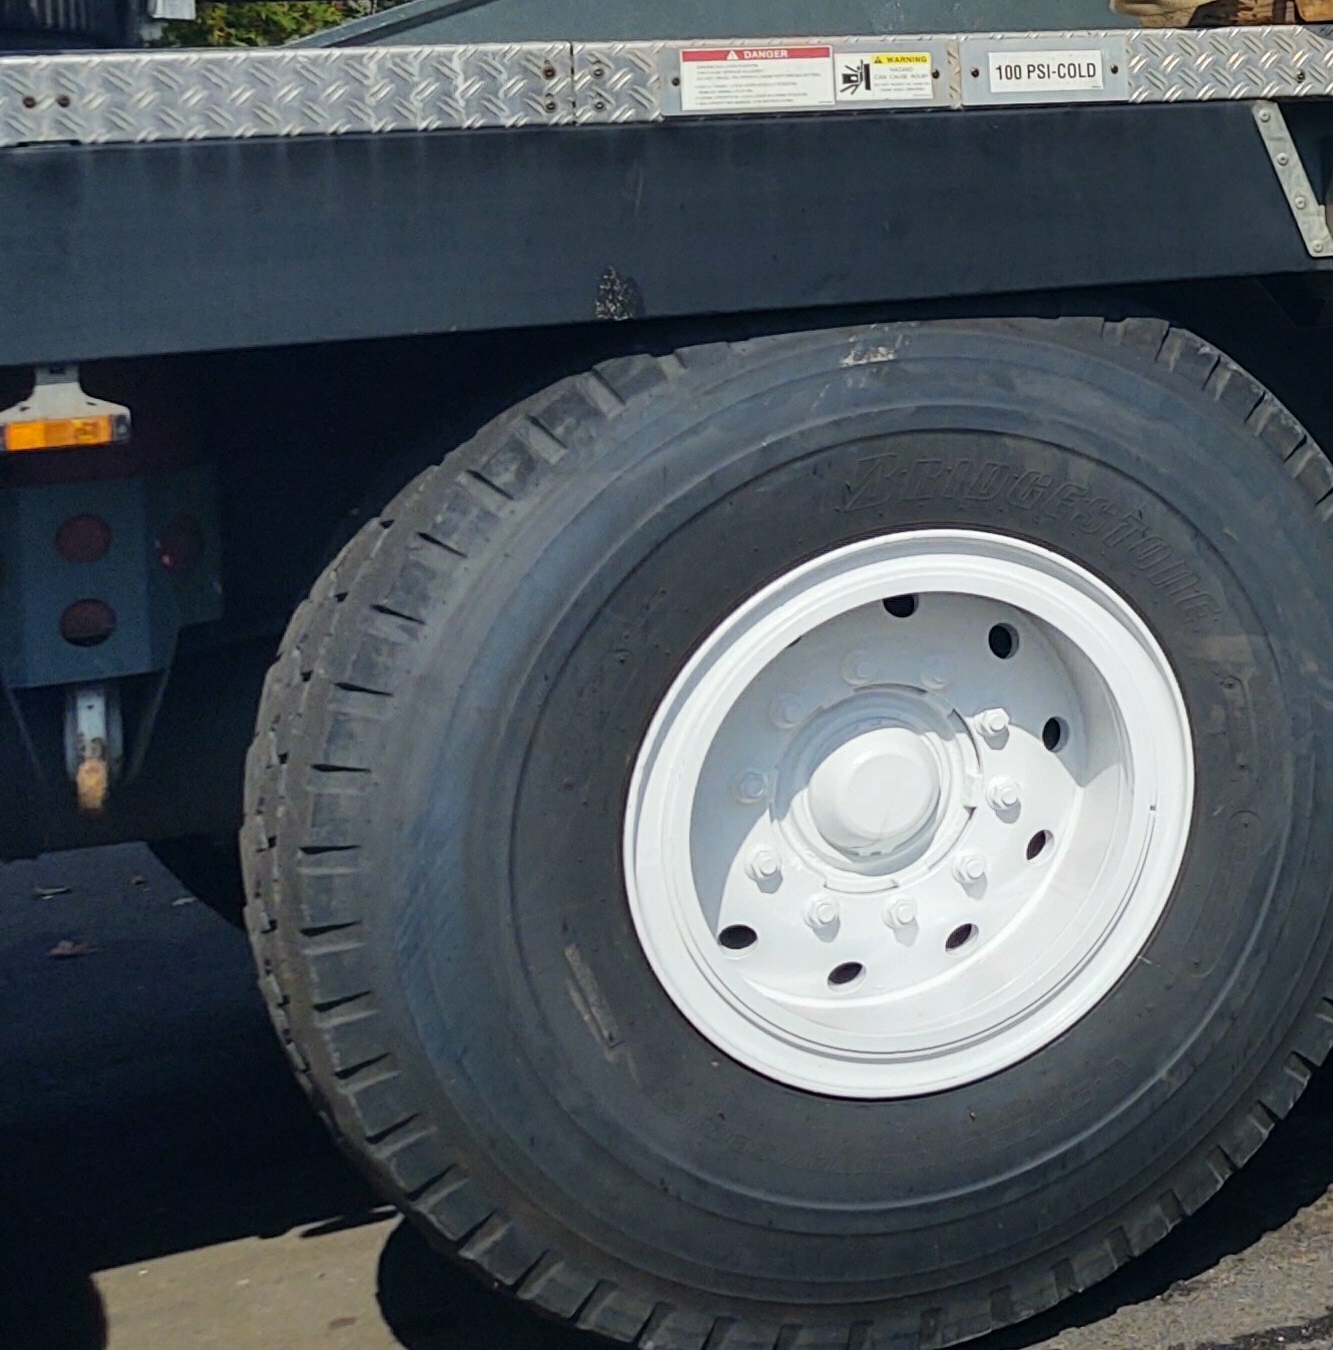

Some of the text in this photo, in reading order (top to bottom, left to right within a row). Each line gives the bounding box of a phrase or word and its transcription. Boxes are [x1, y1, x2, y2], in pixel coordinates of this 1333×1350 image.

[743, 49, 789, 59] DANGER
[886, 55, 928, 64] WARNING
[995, 62, 1097, 81] 100 PSI-COLD
[842, 452, 1222, 623] BRIDGESTONE
